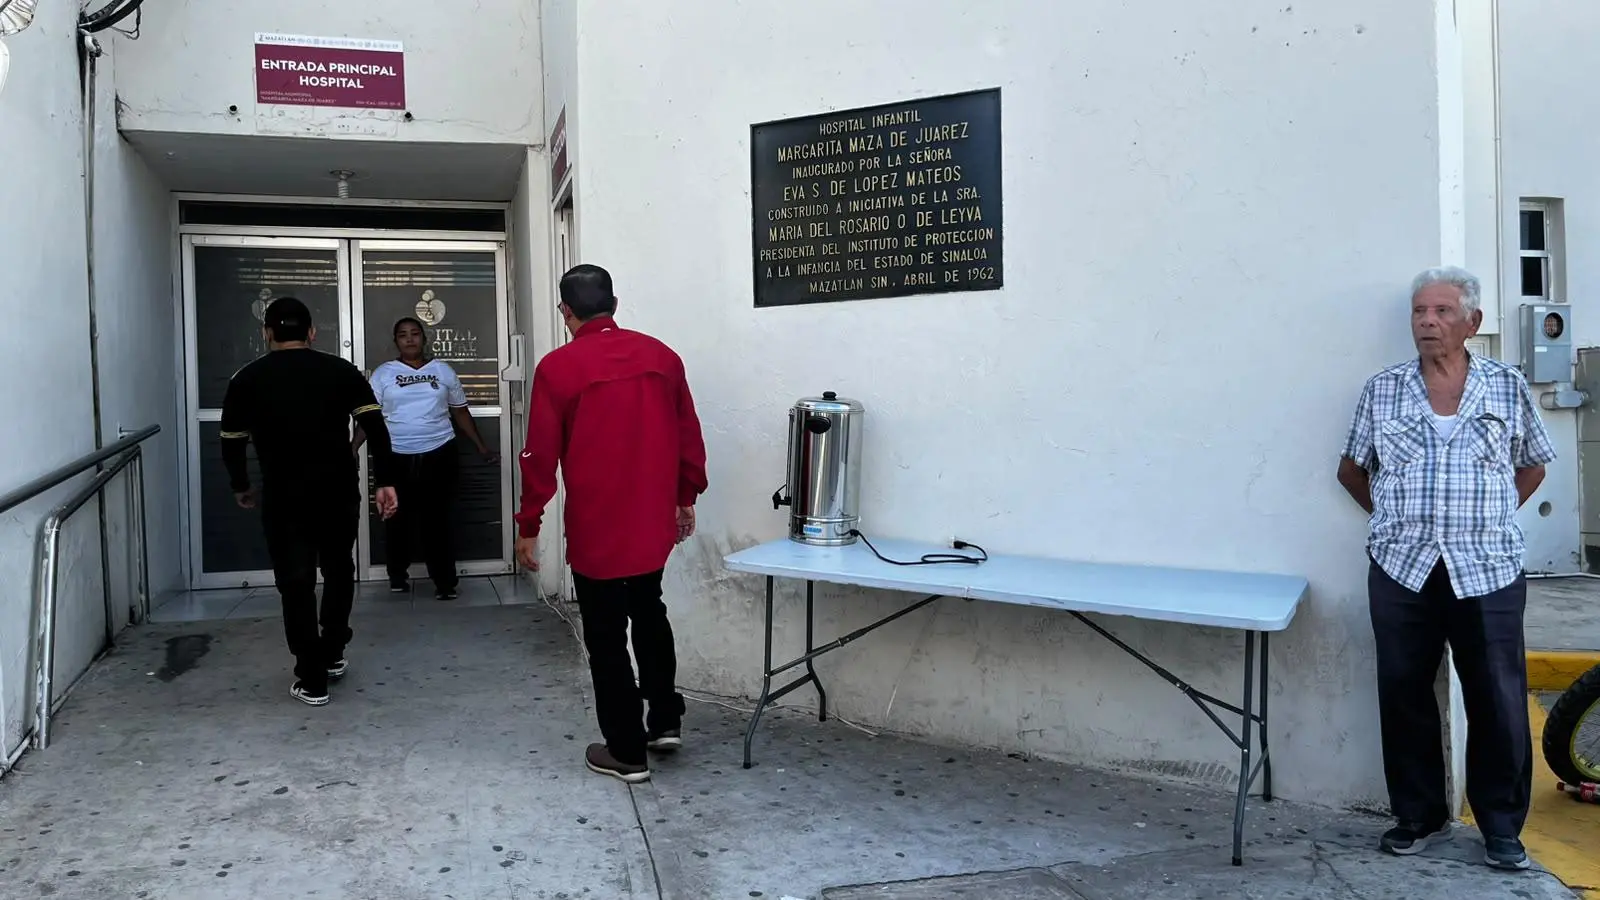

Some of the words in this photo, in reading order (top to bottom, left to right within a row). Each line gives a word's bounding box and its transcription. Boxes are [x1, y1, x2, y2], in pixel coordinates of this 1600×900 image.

[261, 59, 327, 72] ENTRADA
[329, 62, 397, 77] PRINCIPAL
[299, 76, 364, 88] HOSPITAL
[819, 118, 866, 135] HOSPITAL
[872, 110, 922, 128] INFANTIL
[777, 139, 843, 162] MARGARITA
[849, 134, 884, 153] MAZA
[890, 130, 907, 148] DE
[915, 121, 969, 144] JUAREZ
[792, 160, 855, 179] INAUGURADO
[859, 156, 881, 171] POR
[887, 153, 902, 168] LA
[909, 146, 952, 164] SEÑORA
[783, 184, 806, 201] EVA
[830, 180, 847, 196] DE
[854, 172, 898, 193] LOPEZ
[906, 165, 961, 187] MATEOS
[768, 203, 829, 221] CONSTRUIDO
[835, 202, 842, 214] A
[849, 194, 905, 213] INICIATIVA
[911, 192, 926, 206] DE
[933, 189, 948, 203] LA
[956, 186, 981, 201] SRA.
[769, 224, 803, 242] MARIA
[809, 221, 833, 238] DEL
[839, 215, 890, 235] ROSARIO
[916, 211, 933, 227] DE
[941, 206, 982, 225] LEYVA
[760, 245, 815, 261] PRESIDENTA
[822, 242, 840, 255] DEL
[848, 237, 898, 253] INSTITUTO
[904, 234, 918, 248] DE
[925, 227, 993, 246] PROTECCION
[766, 266, 773, 279] A
[778, 264, 791, 278] LA
[797, 260, 841, 277] INFANCIA
[847, 258, 867, 271] DEL
[874, 253, 913, 269] ESTADO
[920, 251, 935, 265] DE
[942, 247, 987, 263] SINALOA
[810, 278, 863, 294] MAZATLAN
[903, 271, 936, 286] ABRIL
[944, 269, 960, 283] DE
[968, 267, 994, 281] 1962
